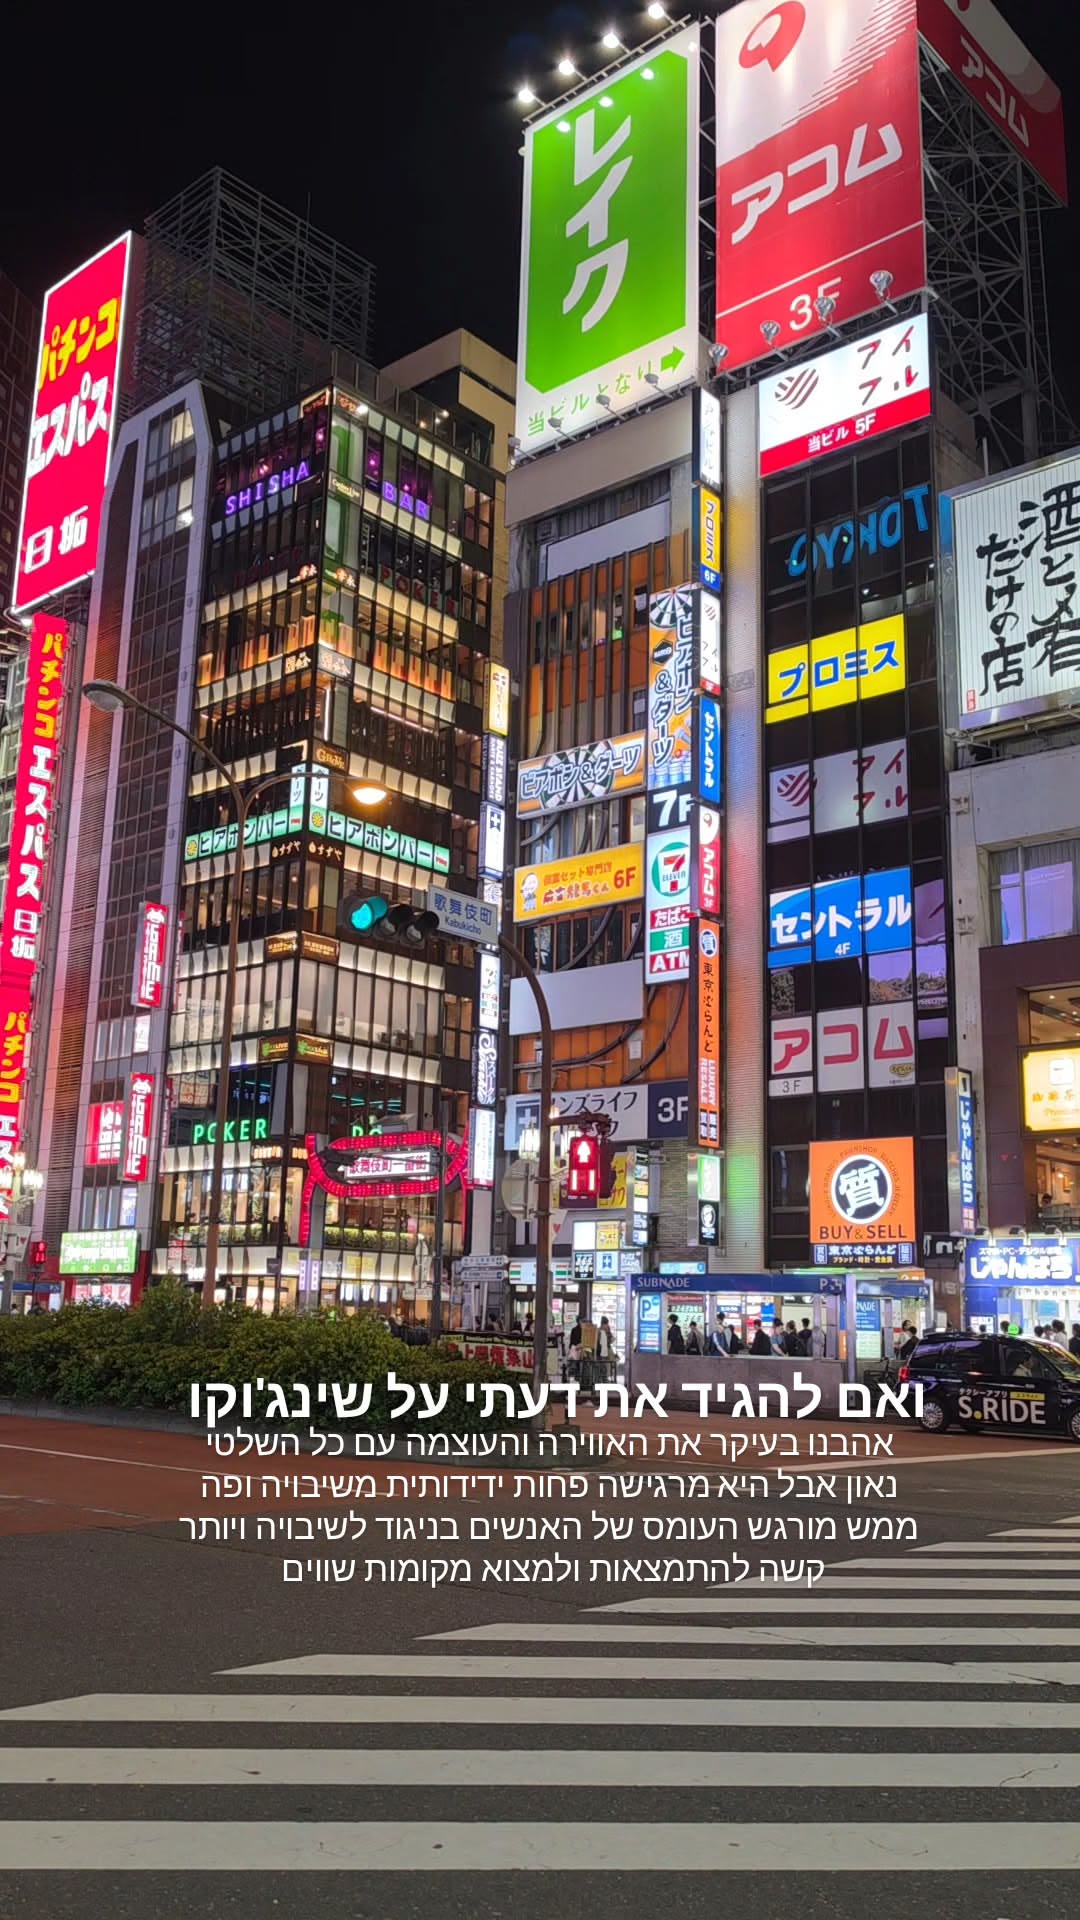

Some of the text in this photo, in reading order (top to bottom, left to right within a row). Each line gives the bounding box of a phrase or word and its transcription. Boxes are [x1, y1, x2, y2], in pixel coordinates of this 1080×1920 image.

[960, 37, 1030, 148] アコム
[731, 121, 903, 245] アコム
[562, 108, 633, 333] レイク
[38, 297, 119, 390] パチンコ
[28, 371, 109, 478] エスパス
[527, 360, 652, 437] 当ビルとなり
[807, 412, 877, 454] 当ビル 5F
[226, 461, 310, 516] SHISHA
[382, 480, 430, 521] BAR
[705, 500, 716, 563] プロミス
[704, 566, 716, 583] 6F
[976, 532, 1036, 696] だけの店
[35, 632, 64, 739] パチンコ
[778, 641, 901, 698] プロミス
[704, 711, 716, 789] セントラル
[16, 745, 52, 901] エスパス
[613, 867, 637, 890] 6F
[704, 848, 716, 897] アコム
[434, 892, 493, 926] 歌舞伎町
[444, 915, 481, 935] Kabukicho
[770, 894, 912, 944] セントラル
[663, 929, 683, 949] 酒
[835, 942, 851, 955] 4F
[0, 1011, 28, 1104] パチンコ
[773, 1017, 914, 1073] アコム
[782, 1079, 801, 1094] 3F
[839, 1163, 884, 1217] 質
[820, 1224, 907, 1240] BUY & SELL
[637, 1277, 691, 1289] SUBNADE
[958, 1396, 1046, 1424] S.RIDE
